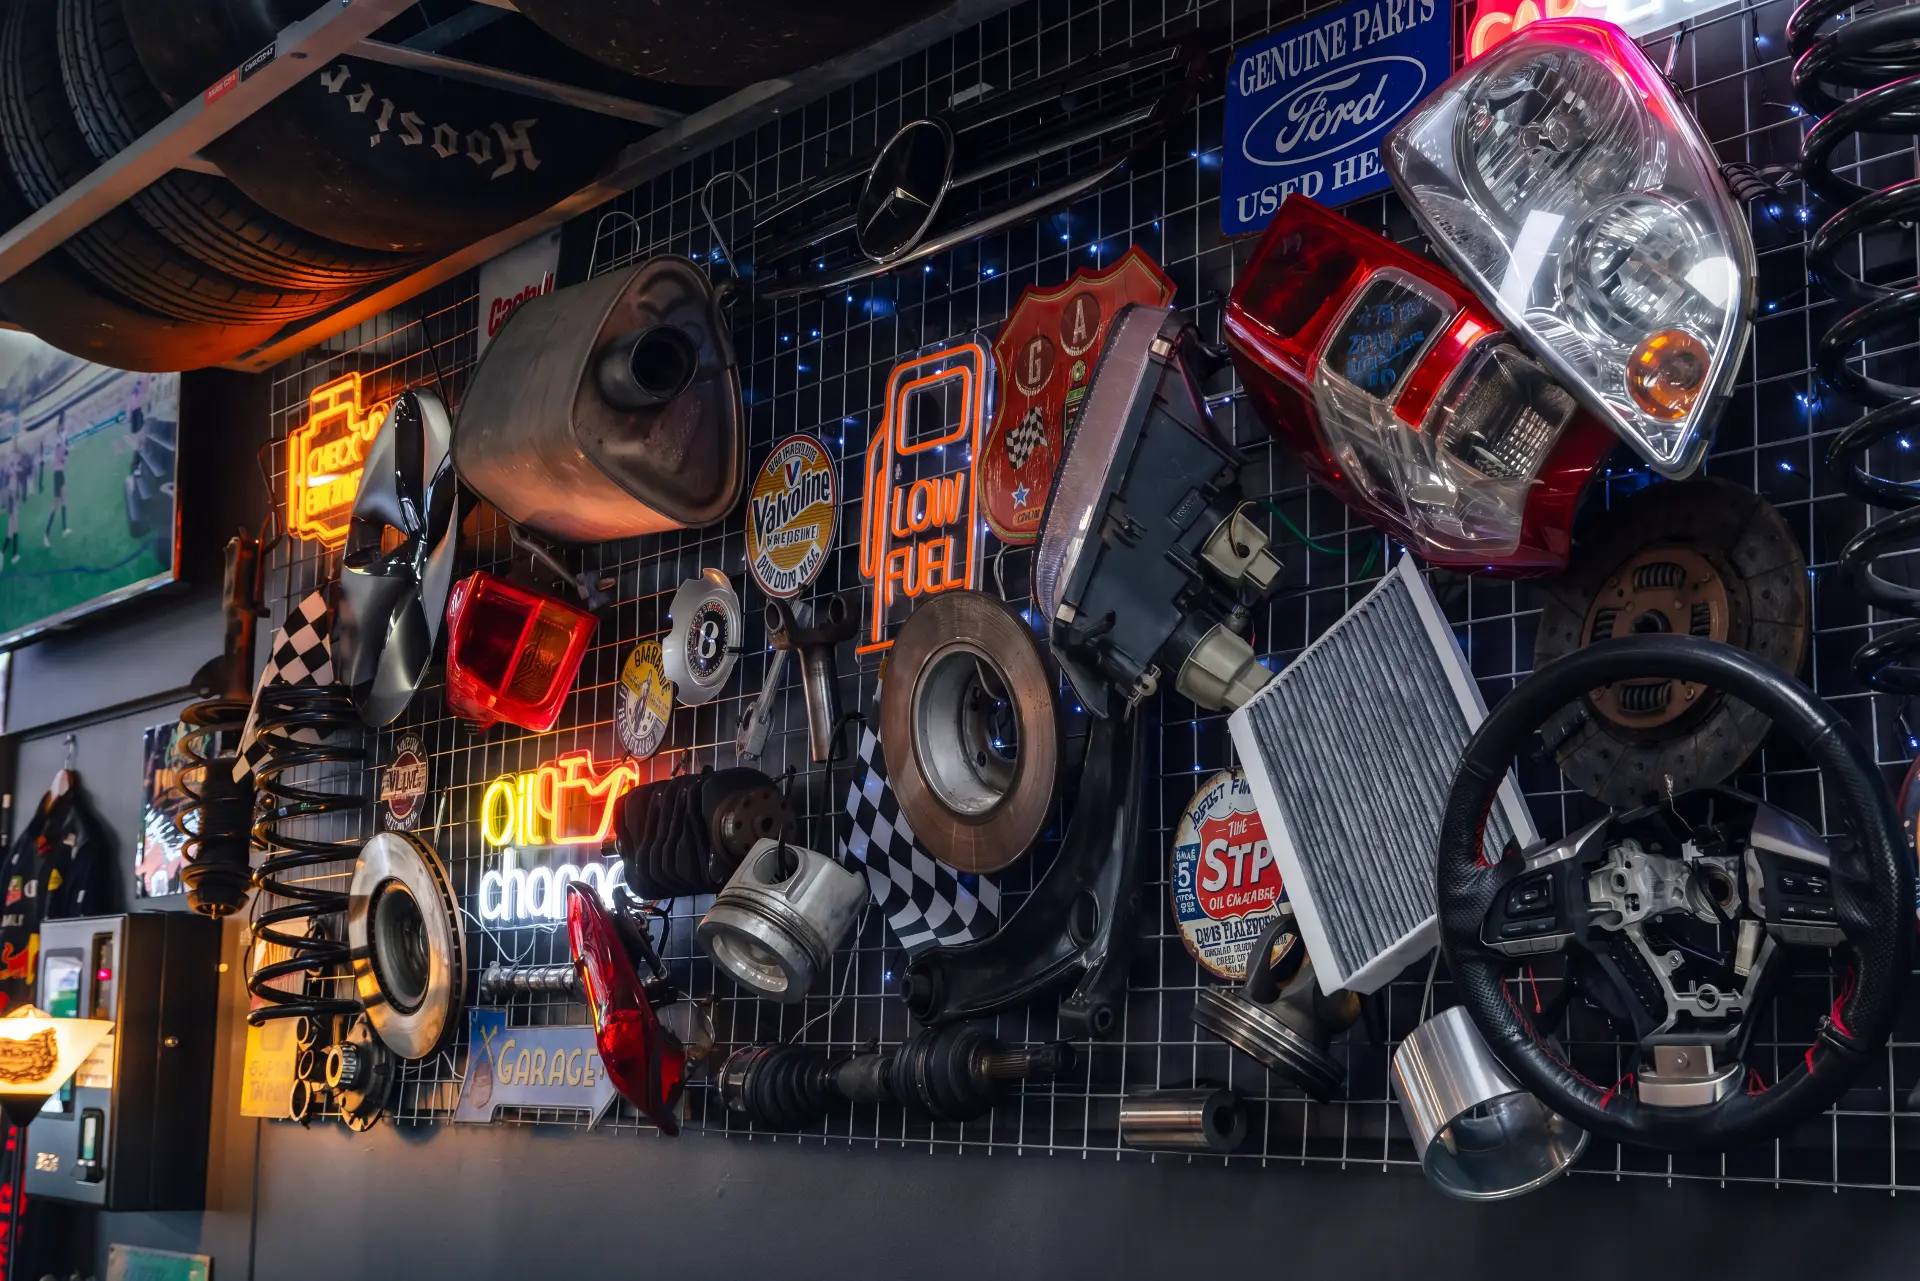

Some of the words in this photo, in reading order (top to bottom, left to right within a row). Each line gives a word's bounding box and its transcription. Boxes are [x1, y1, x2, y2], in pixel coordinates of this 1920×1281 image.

[1239, 17, 1347, 97] GENUINE
[1352, 0, 1435, 51] PARTS
[1275, 72, 1389, 154] Ford
[1236, 170, 1324, 223] USED
[1332, 148, 1387, 191] HE
[1028, 340, 1042, 385] G
[1072, 298, 1088, 344] A
[752, 468, 832, 549] Valvoline
[891, 472, 965, 538] LOW
[885, 535, 964, 606] FUEL
[699, 620, 719, 660] 8
[481, 773, 545, 846] oil
[1178, 861, 1191, 888] 5
[1202, 838, 1275, 893] STP
[1209, 895, 1225, 911] OIL
[497, 1039, 598, 1087] GARAGE
